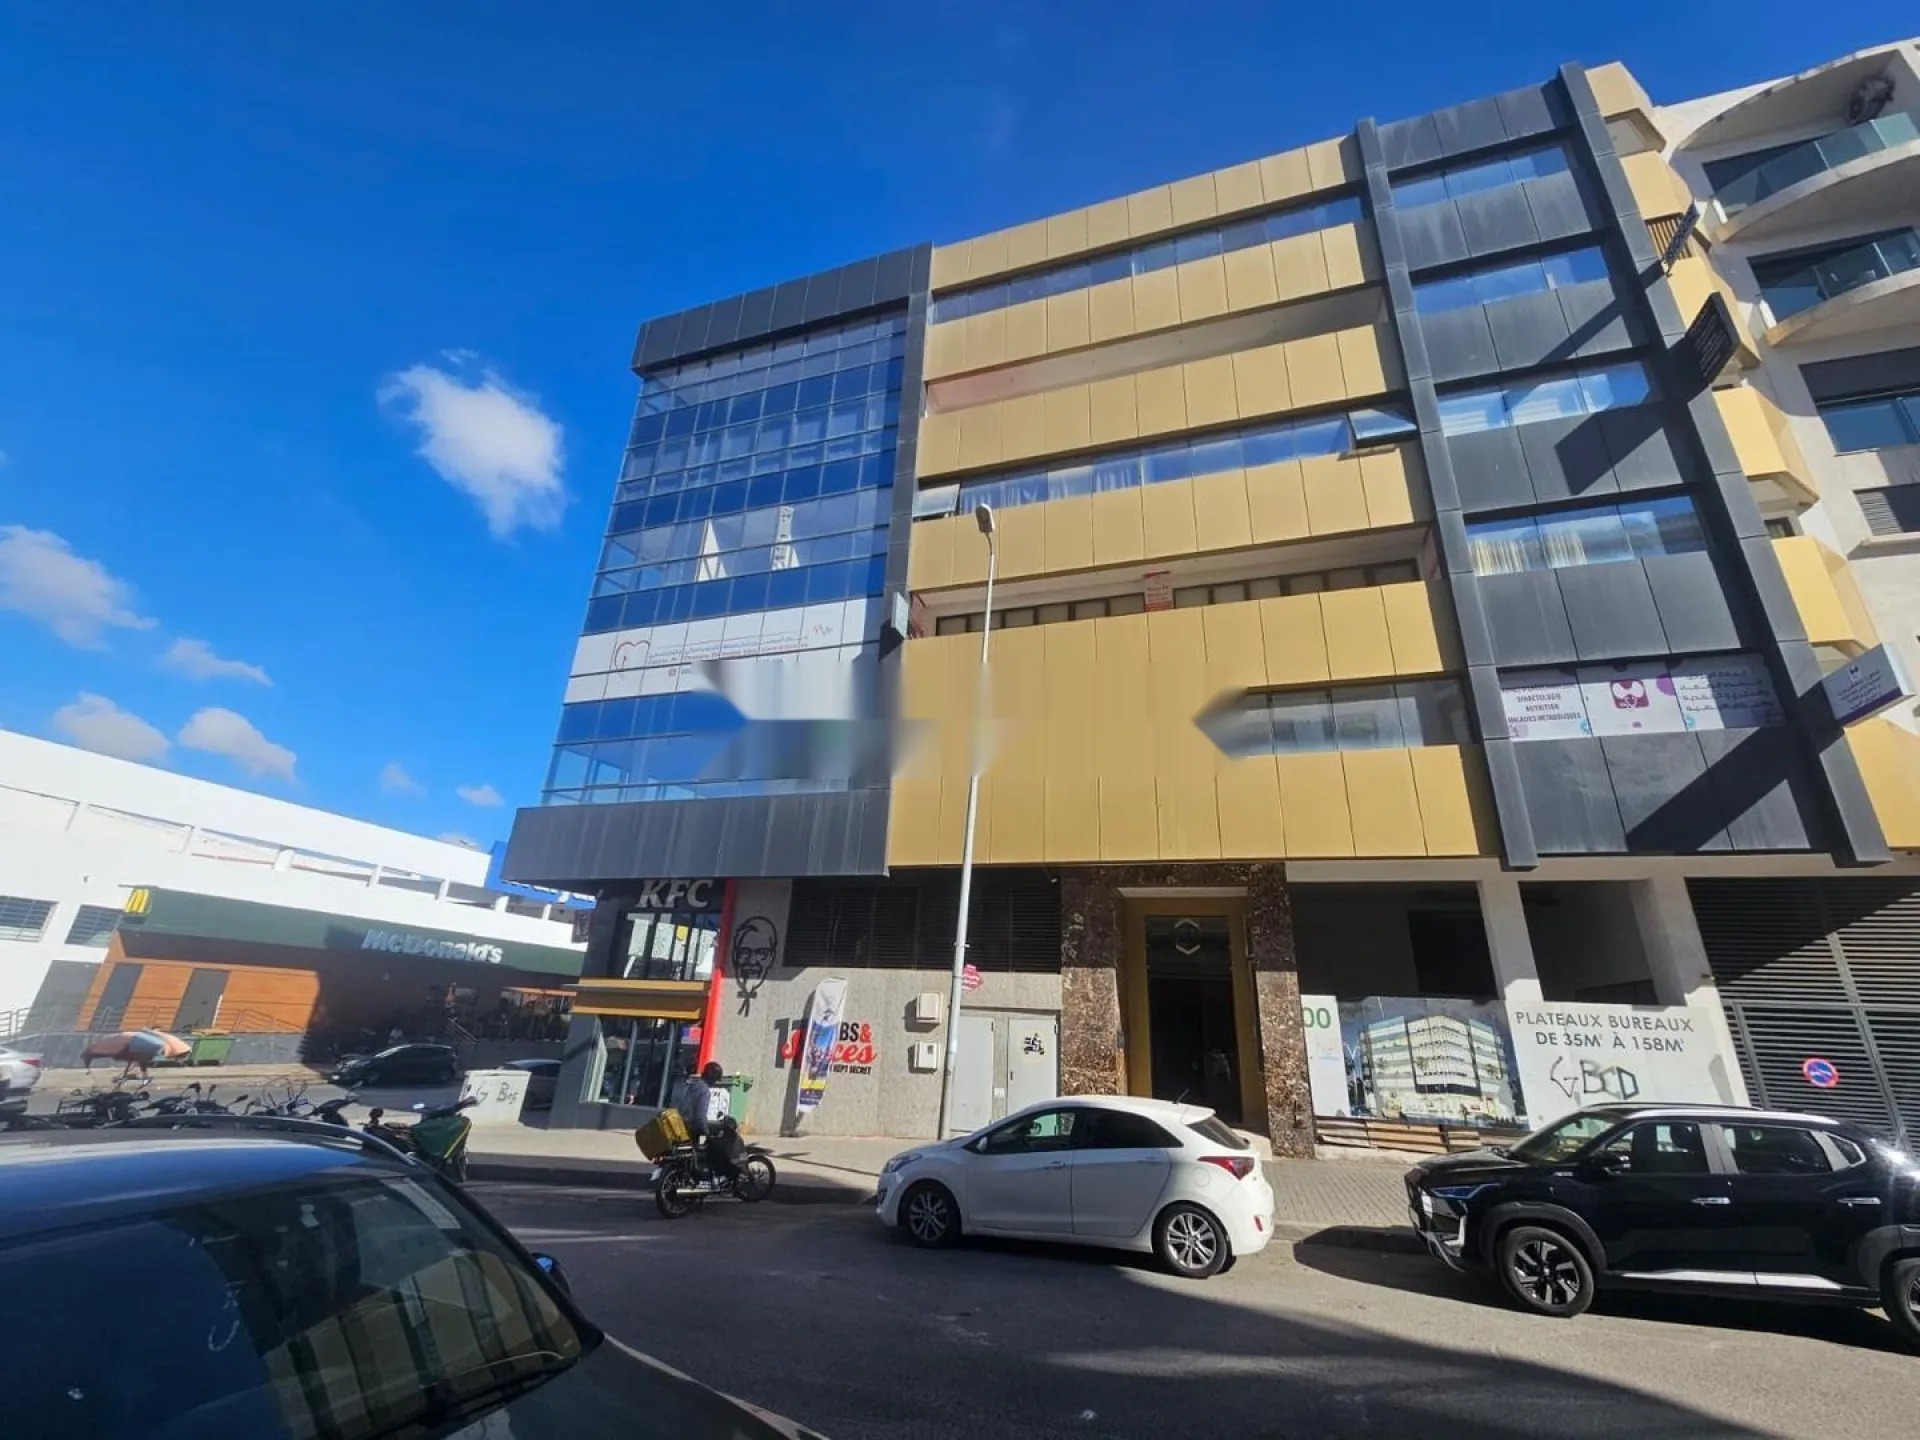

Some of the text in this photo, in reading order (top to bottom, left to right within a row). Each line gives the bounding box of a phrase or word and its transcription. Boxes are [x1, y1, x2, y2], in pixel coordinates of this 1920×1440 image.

[635, 879, 714, 908] KFC
[361, 929, 504, 964] McDonald's
[1515, 1011, 1695, 1032] PLATEAUX BUREAUX
[1536, 1032, 1558, 1046] DE
